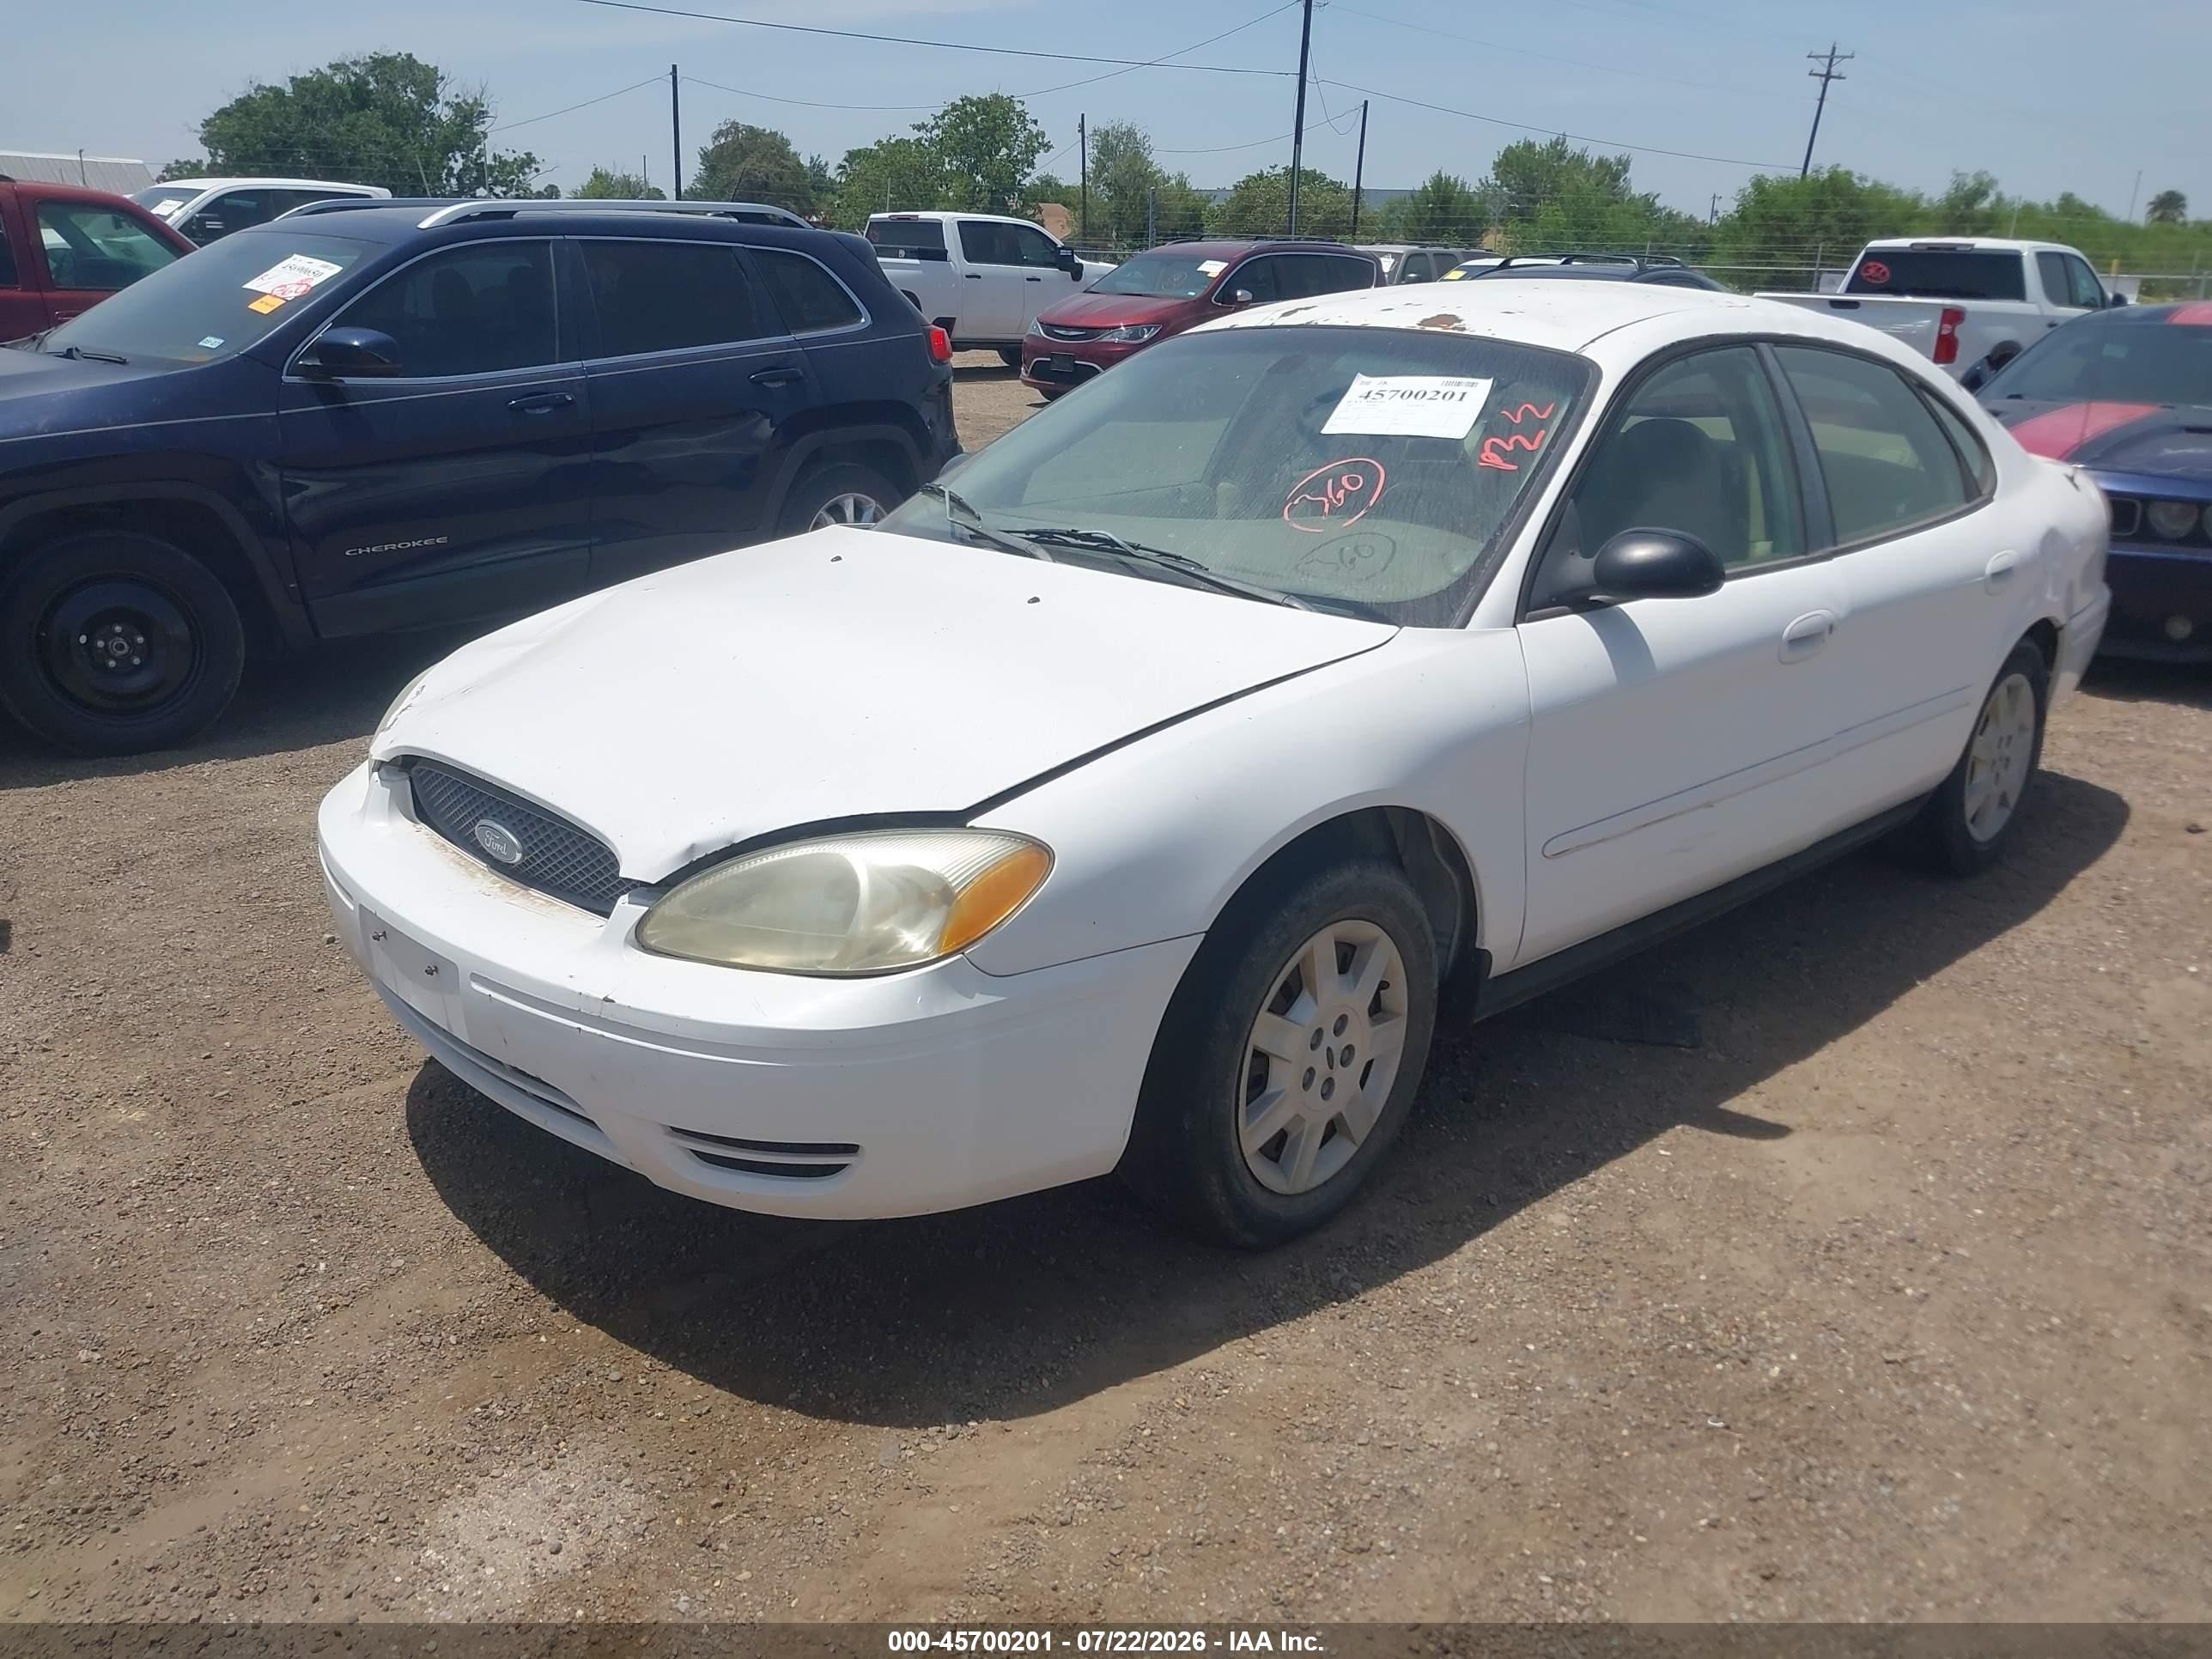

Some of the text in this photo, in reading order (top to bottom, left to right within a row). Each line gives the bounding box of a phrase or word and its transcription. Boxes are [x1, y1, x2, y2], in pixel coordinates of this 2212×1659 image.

[1358, 389, 1469, 402] 45700201
[1292, 473, 1364, 520] 360
[345, 536, 448, 556] CHEROKEE
[484, 830, 508, 856] Ford
